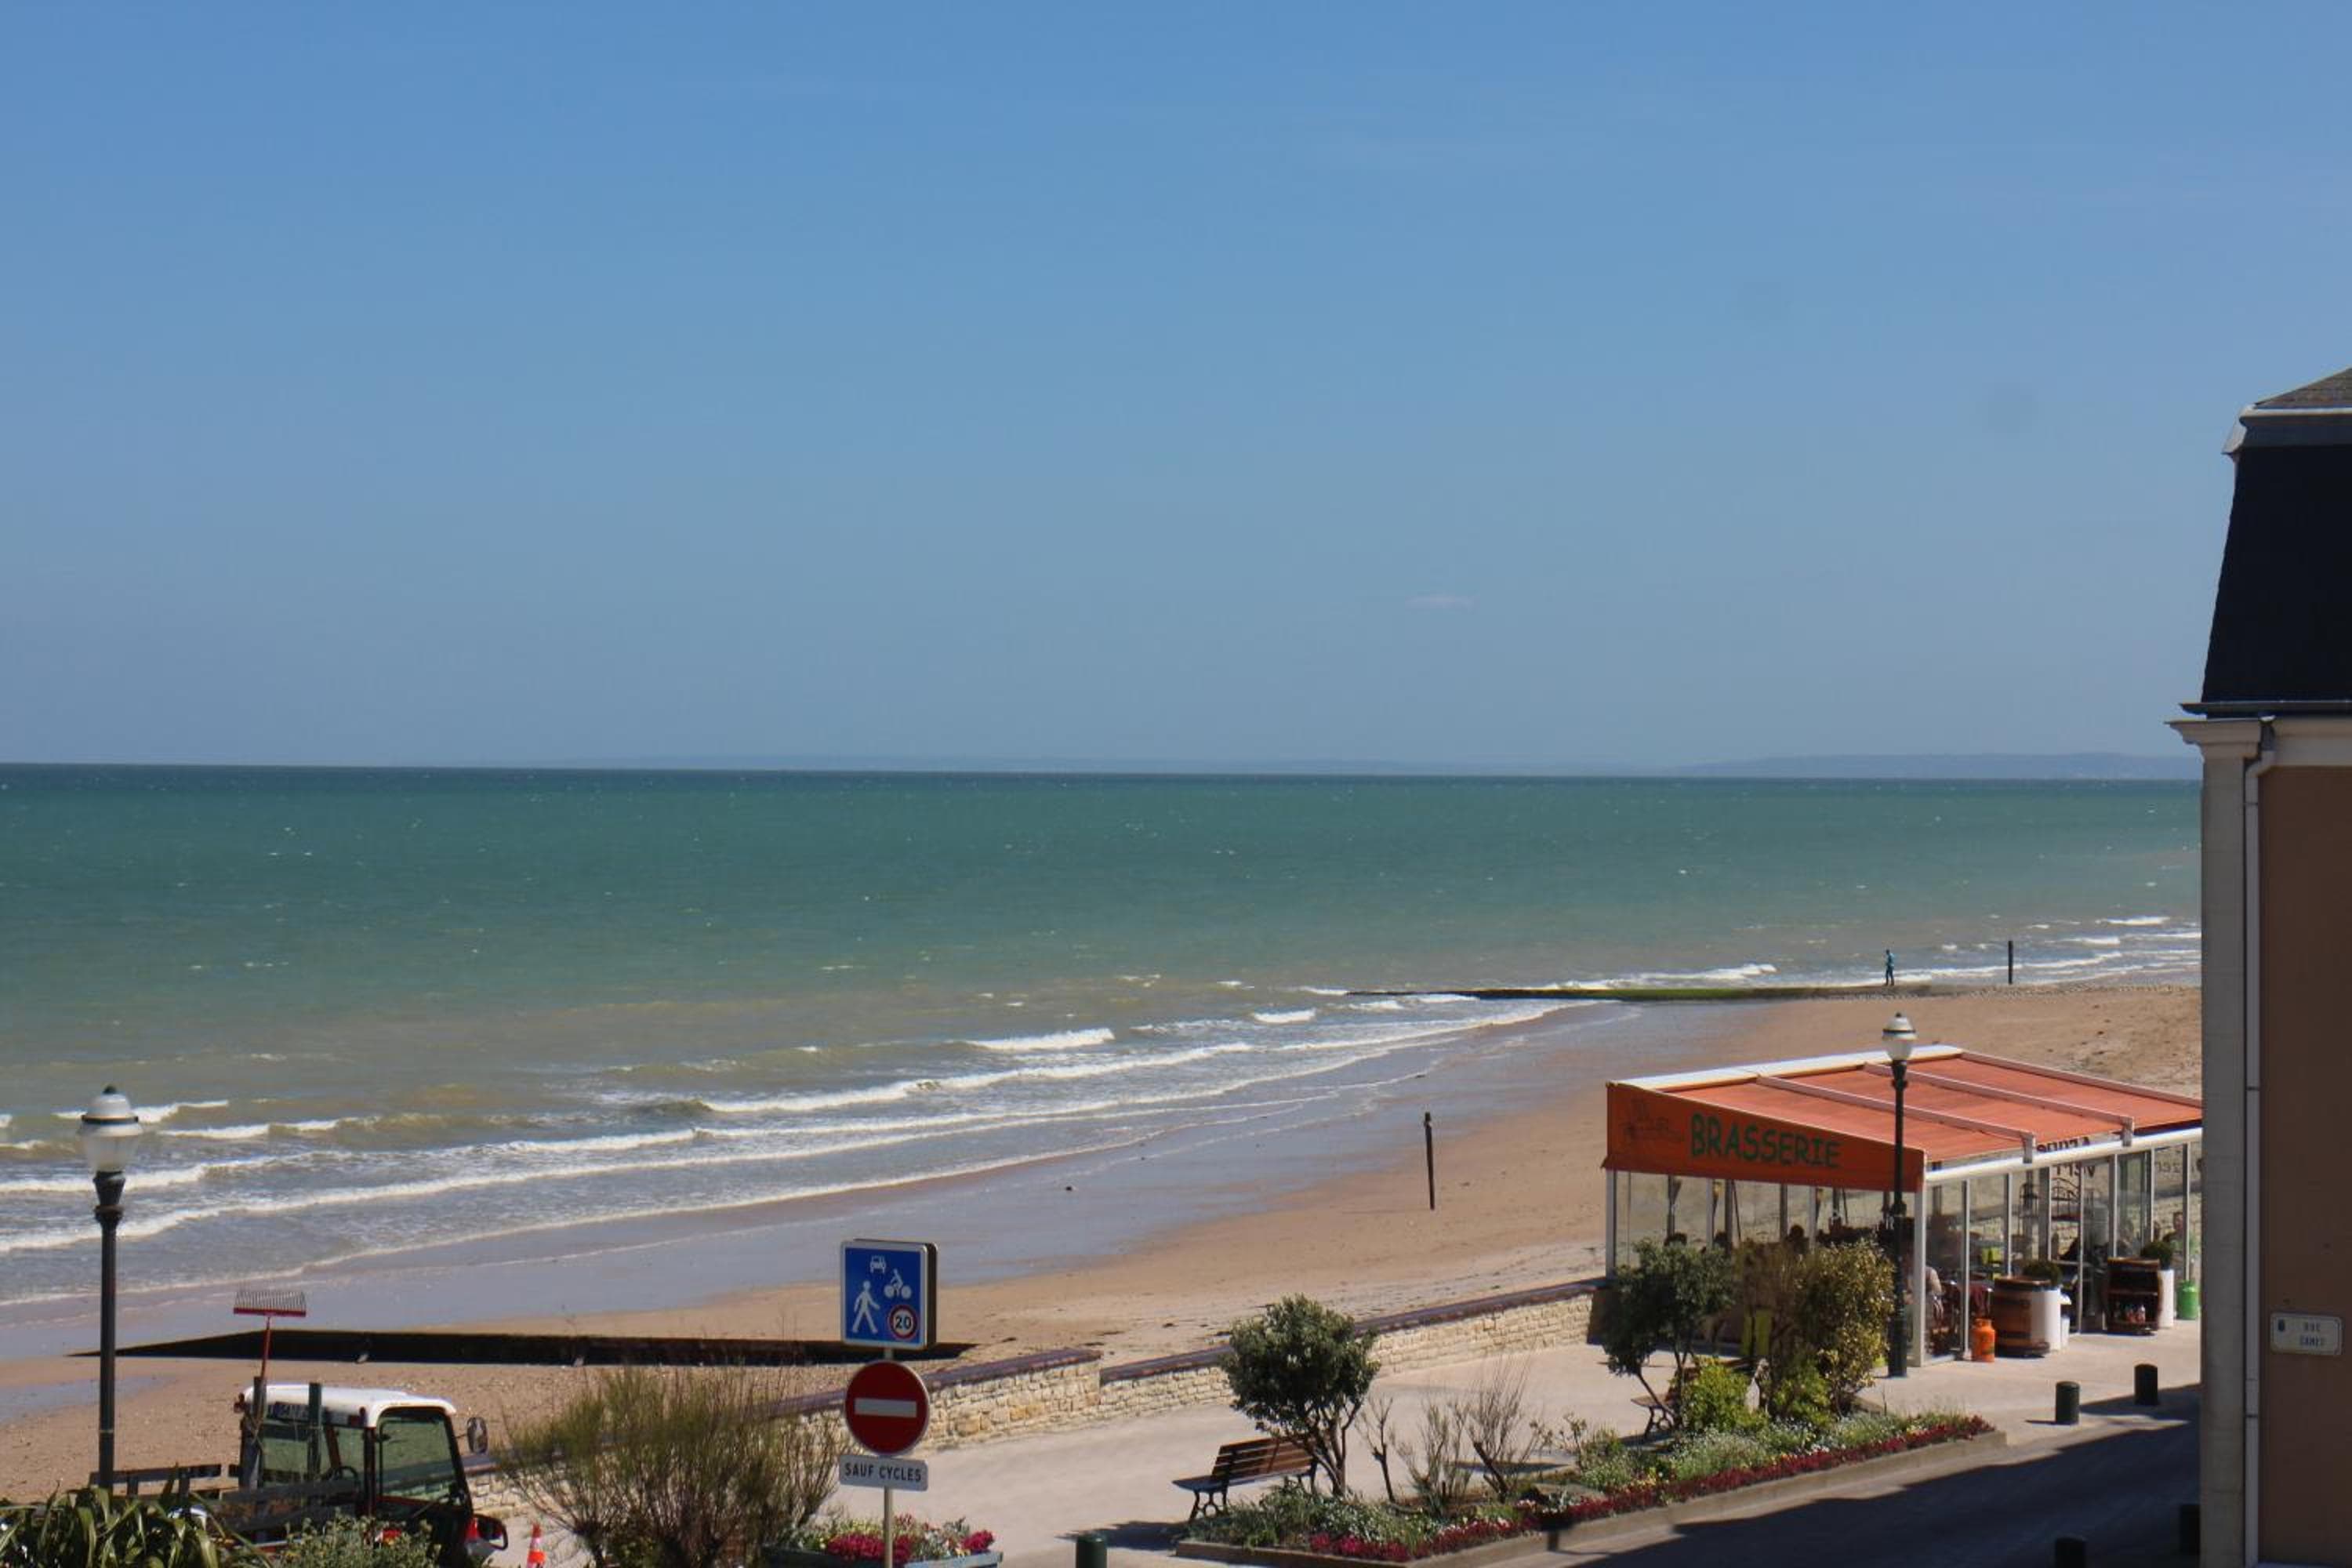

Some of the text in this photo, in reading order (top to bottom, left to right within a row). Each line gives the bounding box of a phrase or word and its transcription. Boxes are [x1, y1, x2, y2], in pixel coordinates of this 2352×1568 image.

[1691, 1112, 1842, 1168] BRASSERIE
[895, 1315, 912, 1330] 20
[844, 1462, 921, 1482] SAUF CYCLES
